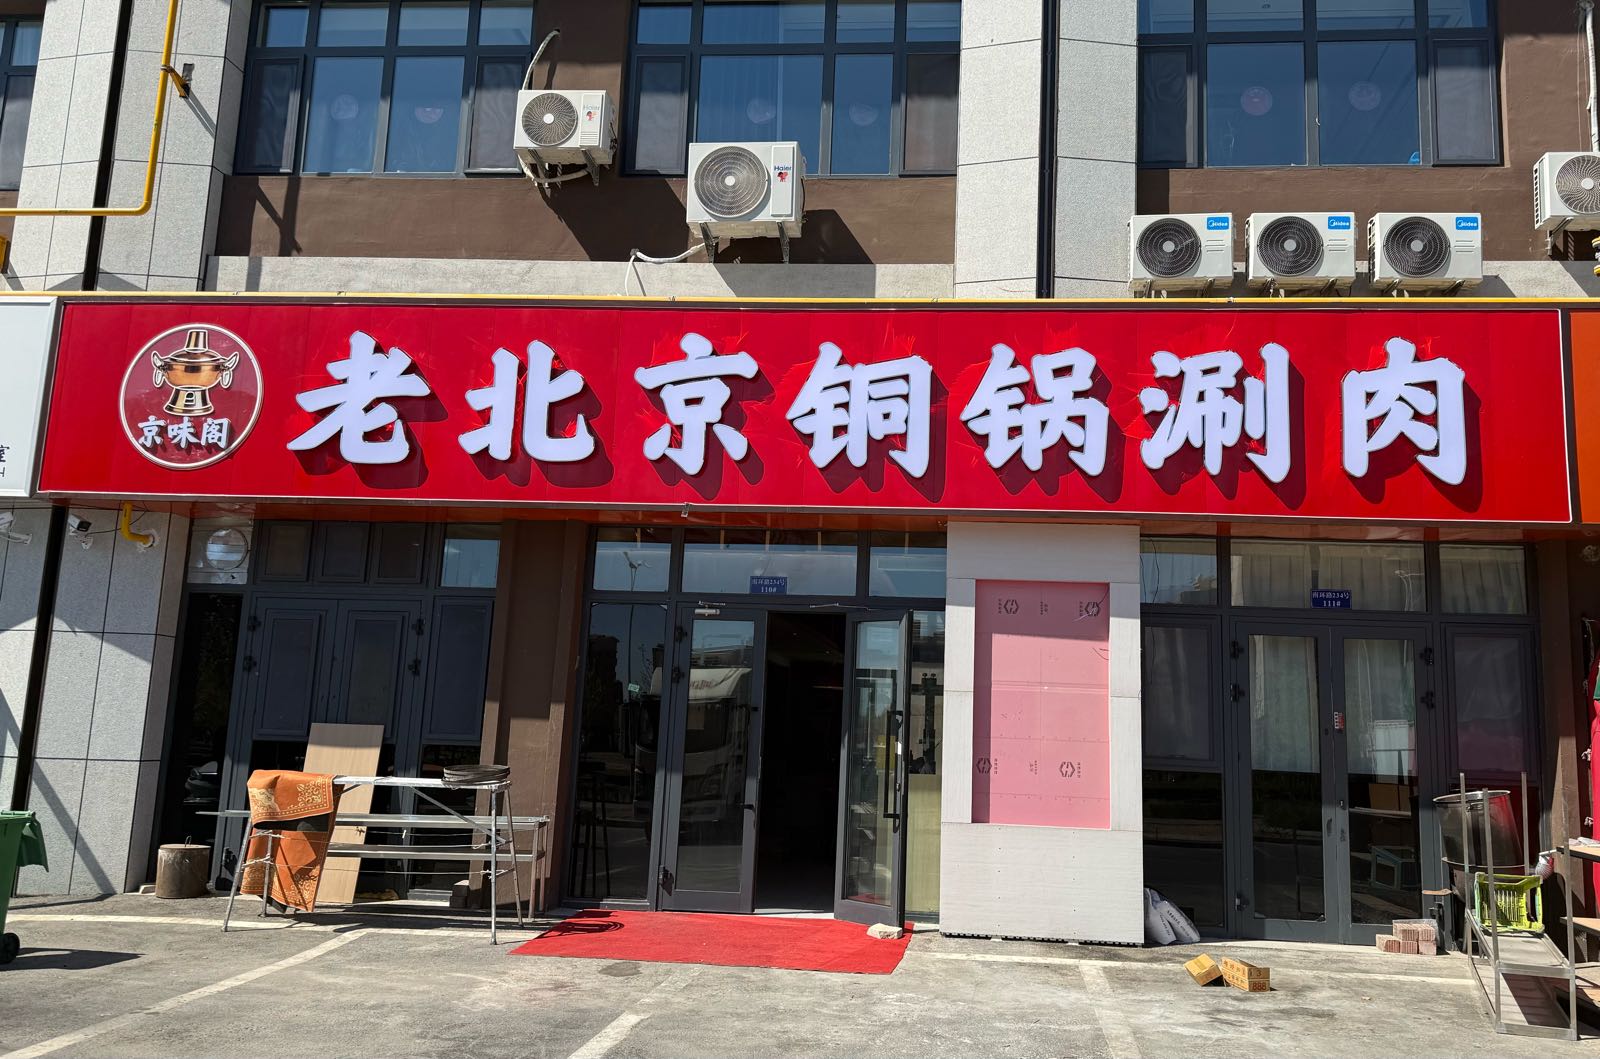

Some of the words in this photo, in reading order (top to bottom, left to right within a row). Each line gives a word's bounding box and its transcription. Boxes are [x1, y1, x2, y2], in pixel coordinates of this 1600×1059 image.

[1329, 218, 1350, 227] Midea
[286, 330, 1467, 485] 老北京铜锅涮肉
[137, 415, 232, 449] 京味阁
